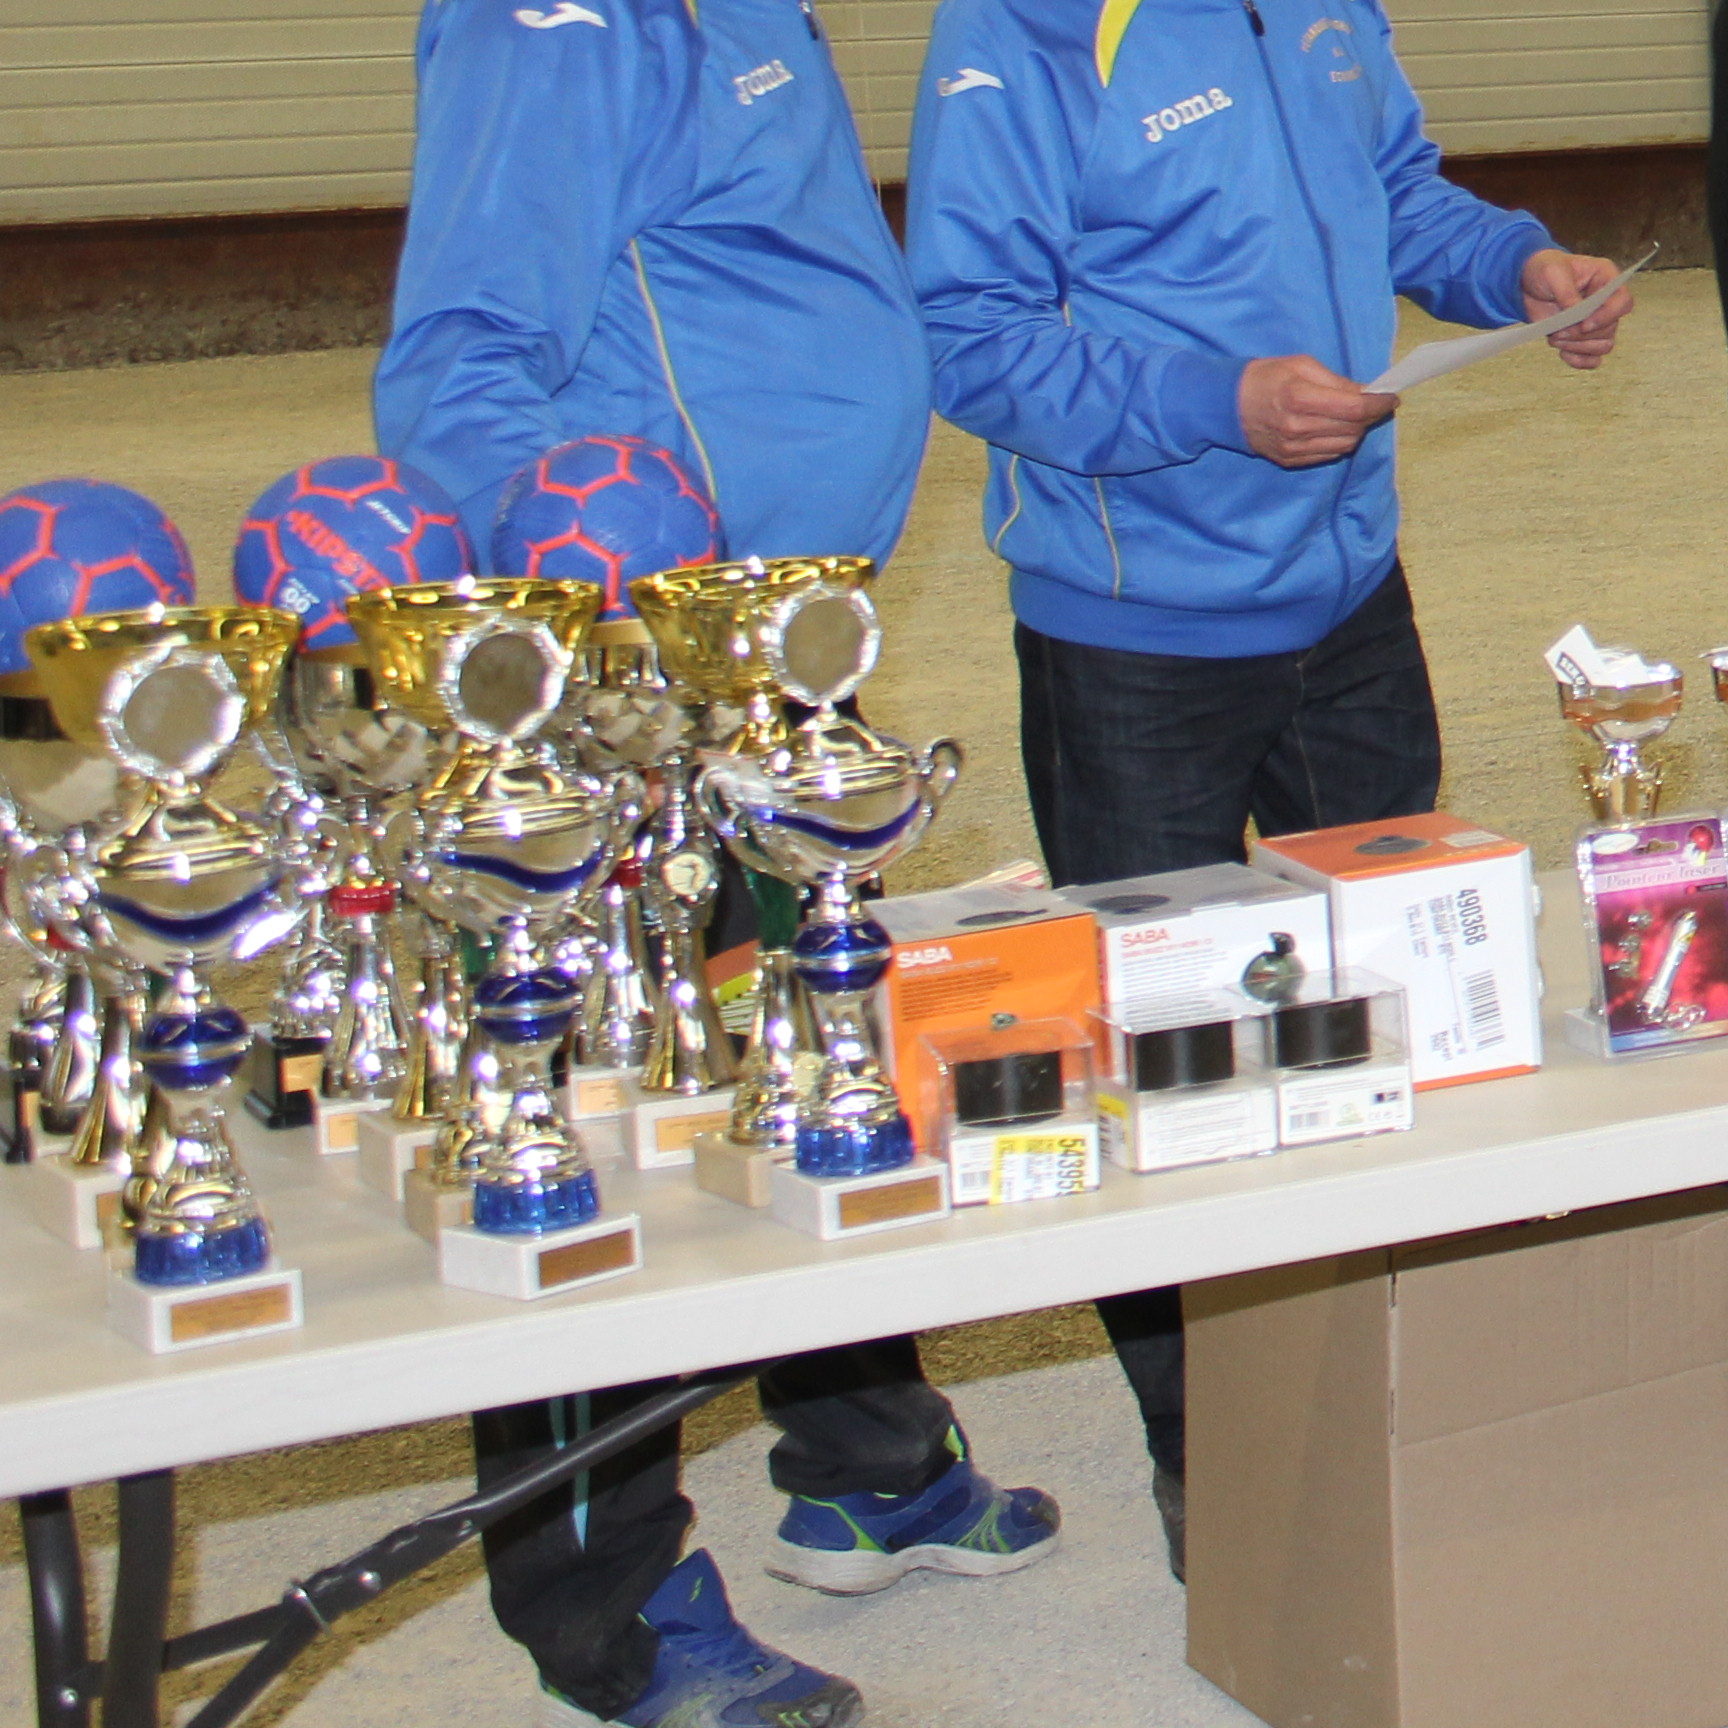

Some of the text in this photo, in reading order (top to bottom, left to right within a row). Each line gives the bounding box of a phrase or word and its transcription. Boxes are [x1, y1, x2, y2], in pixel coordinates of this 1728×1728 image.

[1456, 887, 1490, 947] 490368
[896, 945, 954, 969] SABA
[1120, 928, 1171, 949] SABA
[1056, 1137, 1087, 1198] 54395
